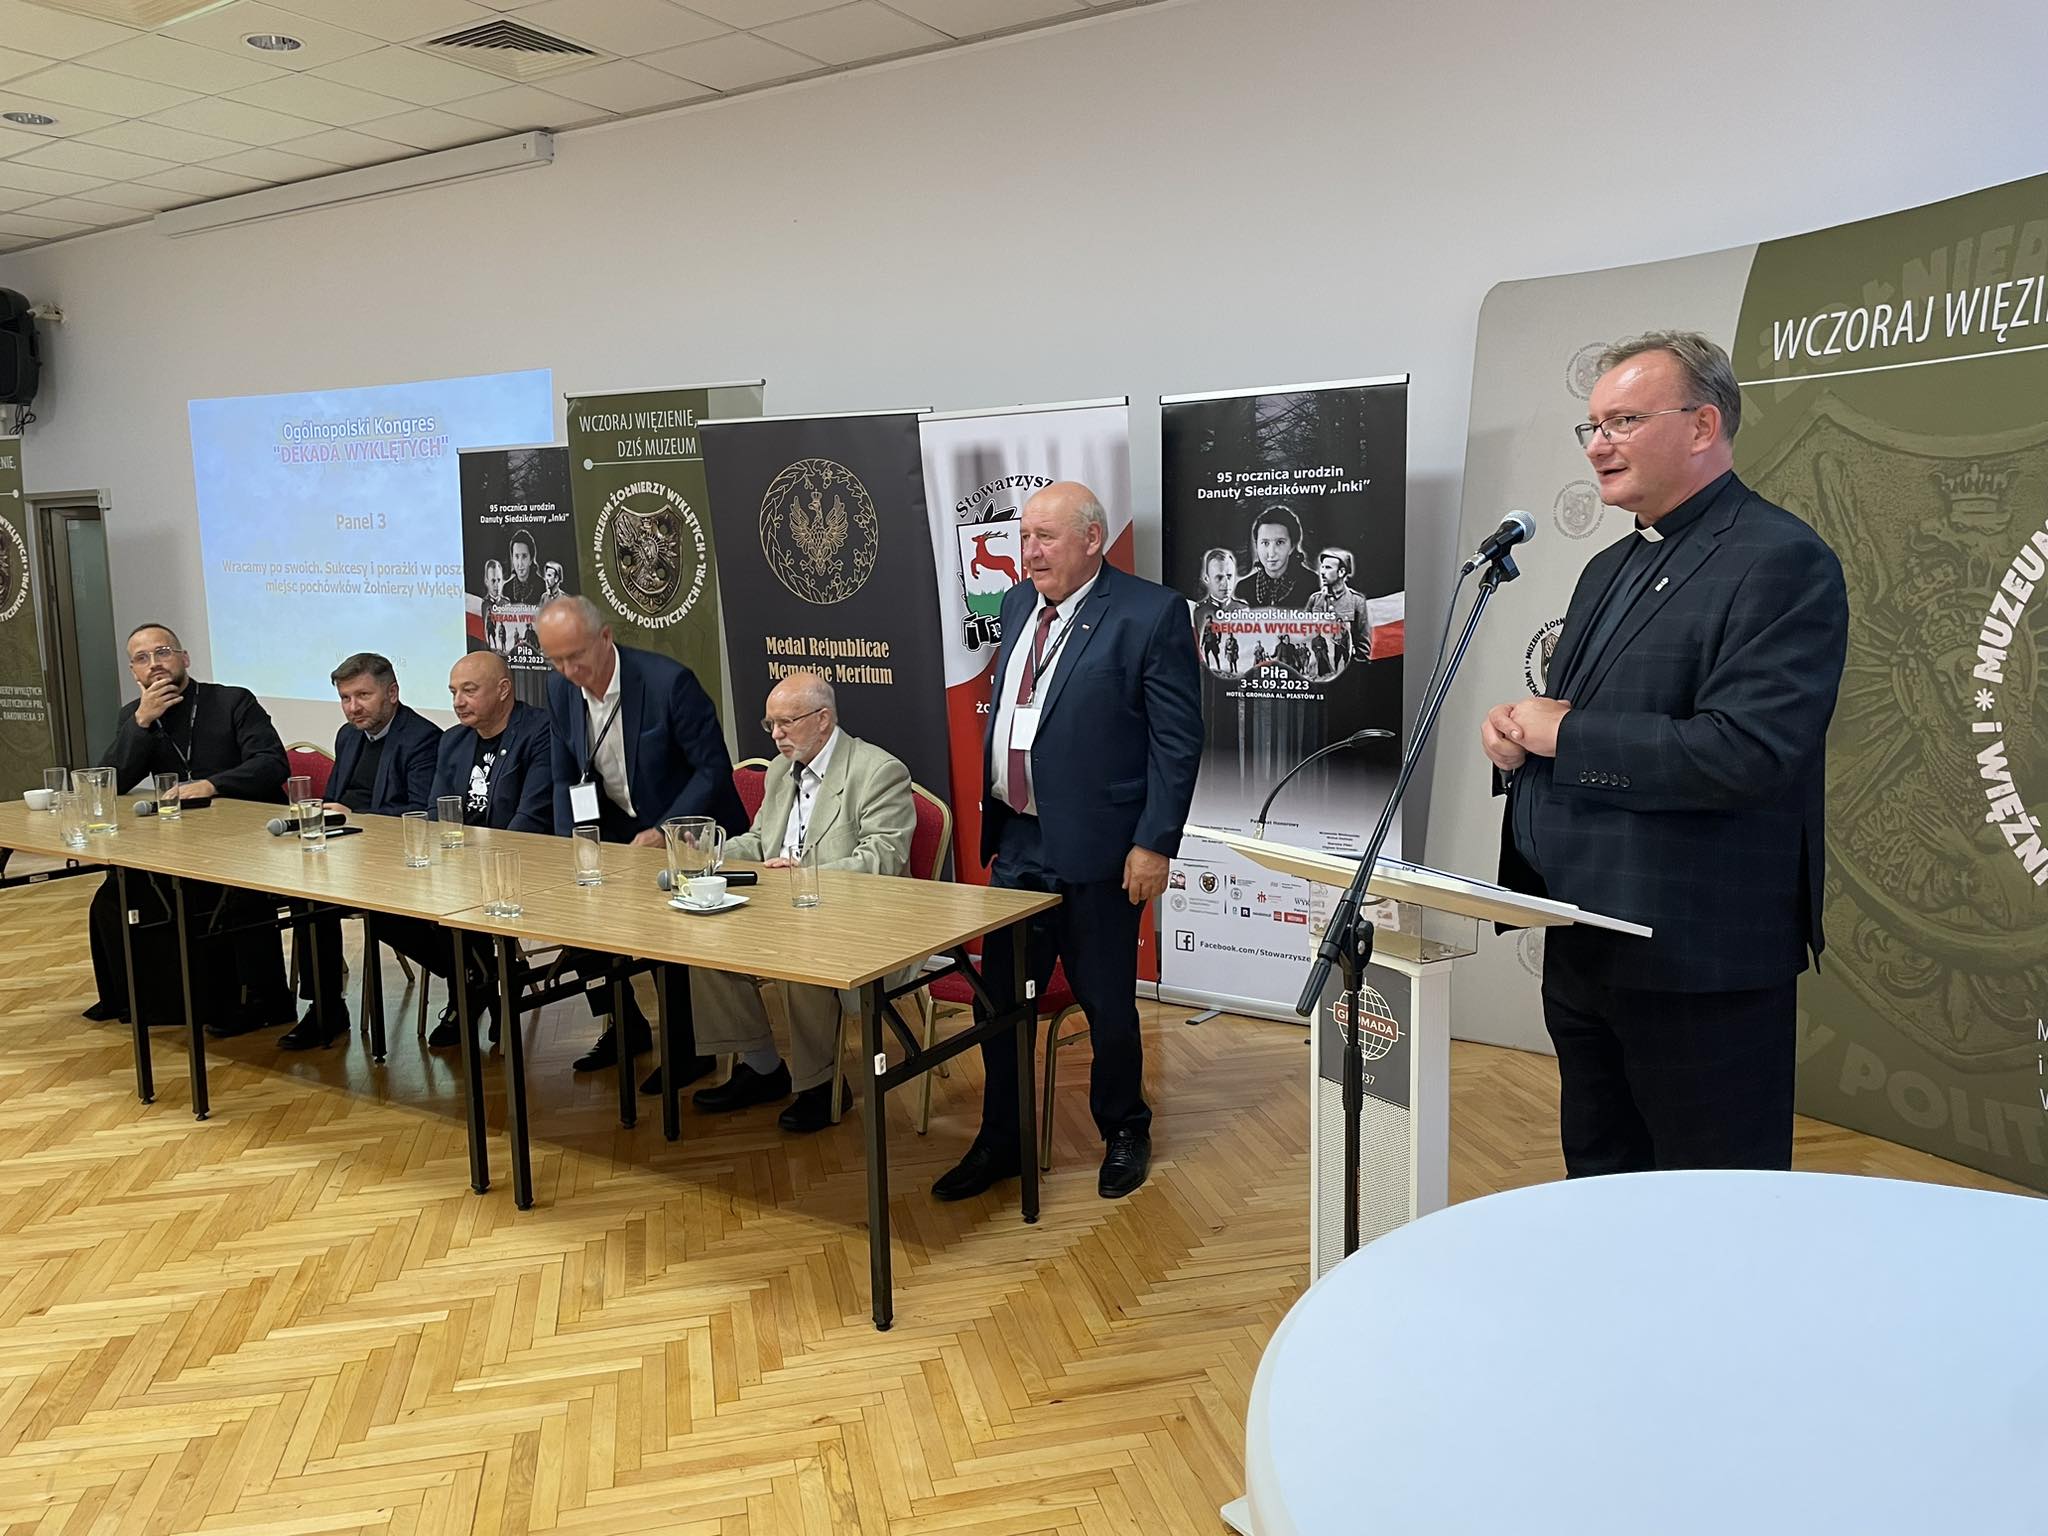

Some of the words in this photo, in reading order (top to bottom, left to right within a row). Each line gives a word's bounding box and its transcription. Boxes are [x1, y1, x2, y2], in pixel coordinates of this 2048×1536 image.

[1773, 296, 1935, 361] WCZORAJ
[1945, 274, 2048, 343] WIĘZI
[283, 417, 370, 443] Ogólnopolski
[374, 416, 435, 438] Kongres
[579, 413, 633, 432] WCZORAJ
[634, 409, 698, 433] WIĘZIENIE,
[273, 443, 341, 464] "DEKADA
[617, 436, 642, 457] DZIŚ
[645, 437, 697, 456] MUZEUM
[1217, 472, 1232, 483] 95
[1236, 469, 1290, 482] rocznica
[1293, 465, 1344, 479] urodzin
[1197, 487, 1241, 500] Danuty
[1244, 482, 1327, 497] Siedzikówny
[489, 504, 498, 512] 95
[499, 503, 528, 512] rocznica
[529, 502, 556, 511] urodzin
[609, 481, 666, 507] ŻOŁNIERZY
[666, 488, 706, 552] WYKLĘTYCH
[336, 512, 373, 530] Panel
[377, 512, 387, 530] 3
[480, 515, 503, 525] Danuty
[593, 502, 614, 552] MUZEUM
[222, 560, 267, 575] Wracamy
[270, 562, 282, 576] po
[324, 561, 368, 578] Sukcesy
[370, 561, 375, 575] i
[376, 561, 418, 578] porażki
[421, 563, 432, 575] w
[265, 579, 298, 595] miejsc
[299, 579, 361, 595] pochówków
[597, 571, 638, 622] WIĘŹNIÓW
[637, 585, 701, 629] POLITYCZNYCH
[694, 562, 707, 587] PRL
[1215, 609, 1287, 622] Ogólnopolski
[1289, 609, 1336, 621] Kongres
[765, 636, 806, 655] Medal
[808, 637, 890, 659] Reipublicae
[1525, 628, 1546, 659] MUZEUM
[835, 664, 893, 684] Meritum
[1260, 666, 1288, 679] Piła
[1240, 679, 1310, 690] 3-5.09.2023
[1337, 1008, 1394, 1036] GMADA
